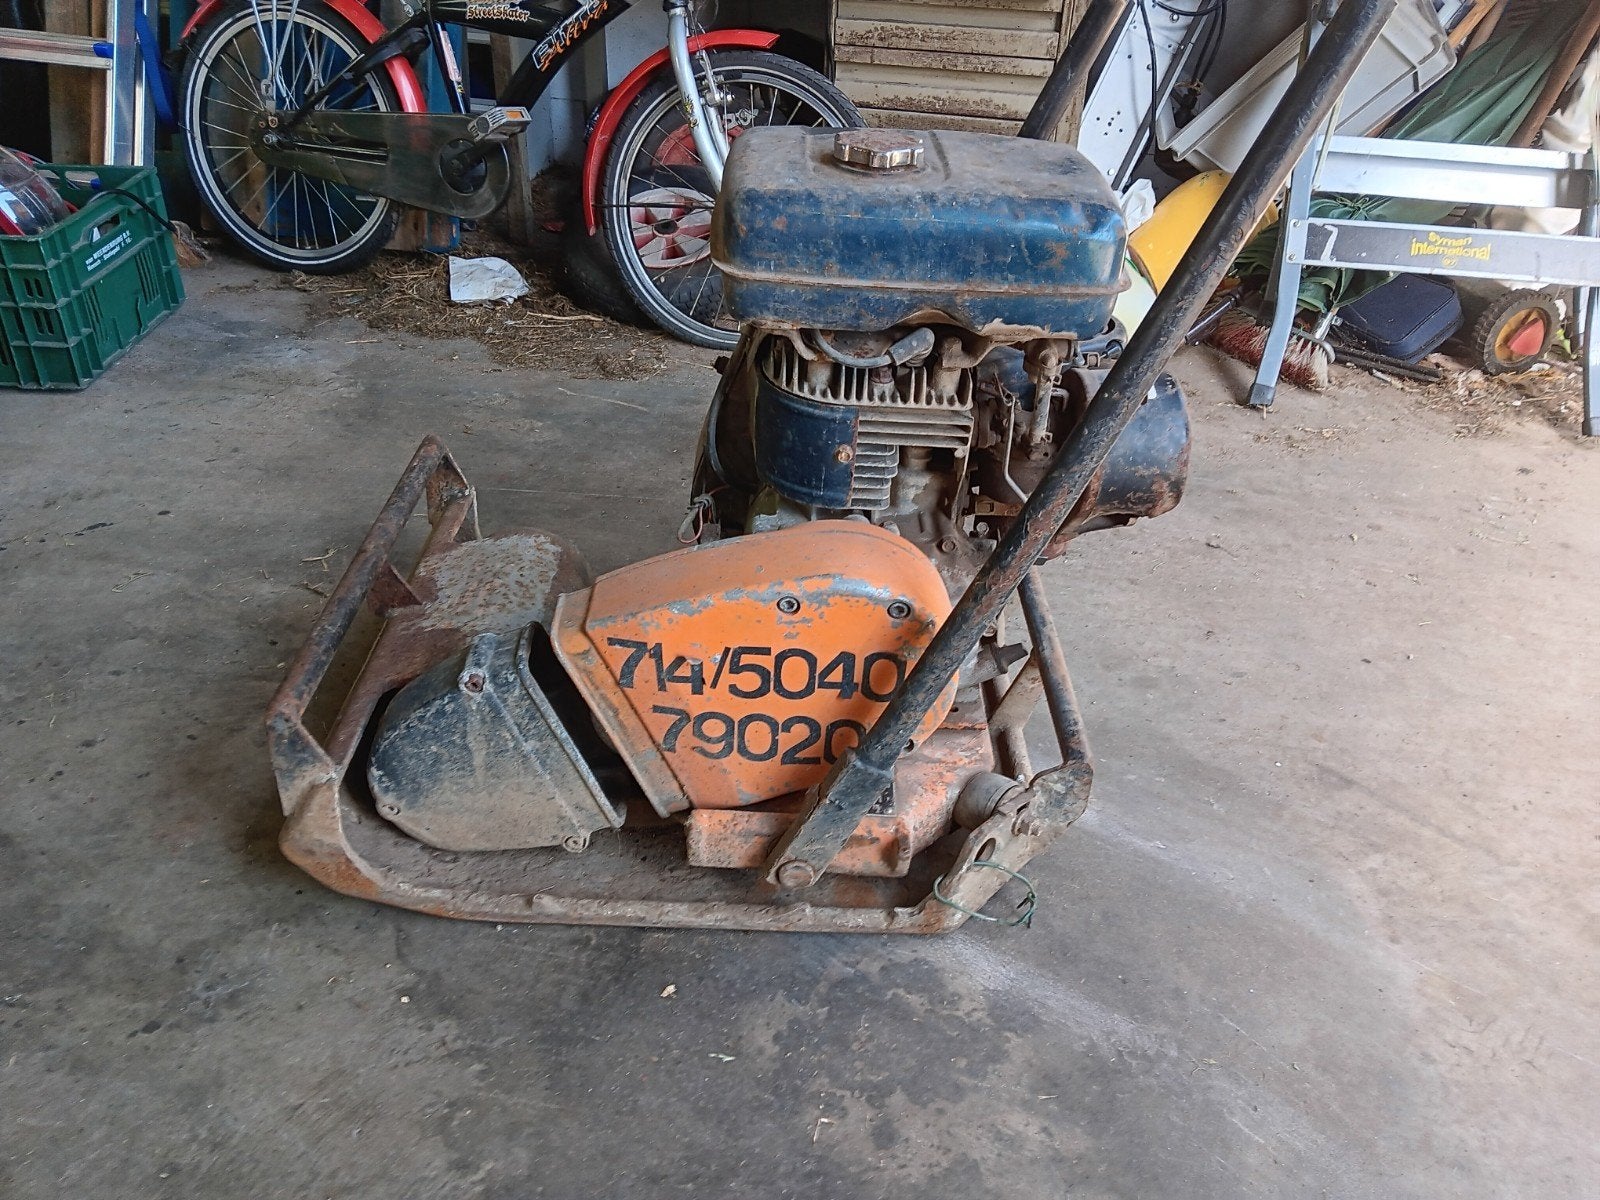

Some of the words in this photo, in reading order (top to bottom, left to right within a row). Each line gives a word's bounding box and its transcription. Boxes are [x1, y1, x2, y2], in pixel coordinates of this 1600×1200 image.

[466, 4, 531, 21] StreetSkater
[606, 636, 908, 703] 714/5040
[651, 704, 868, 766] 79020
